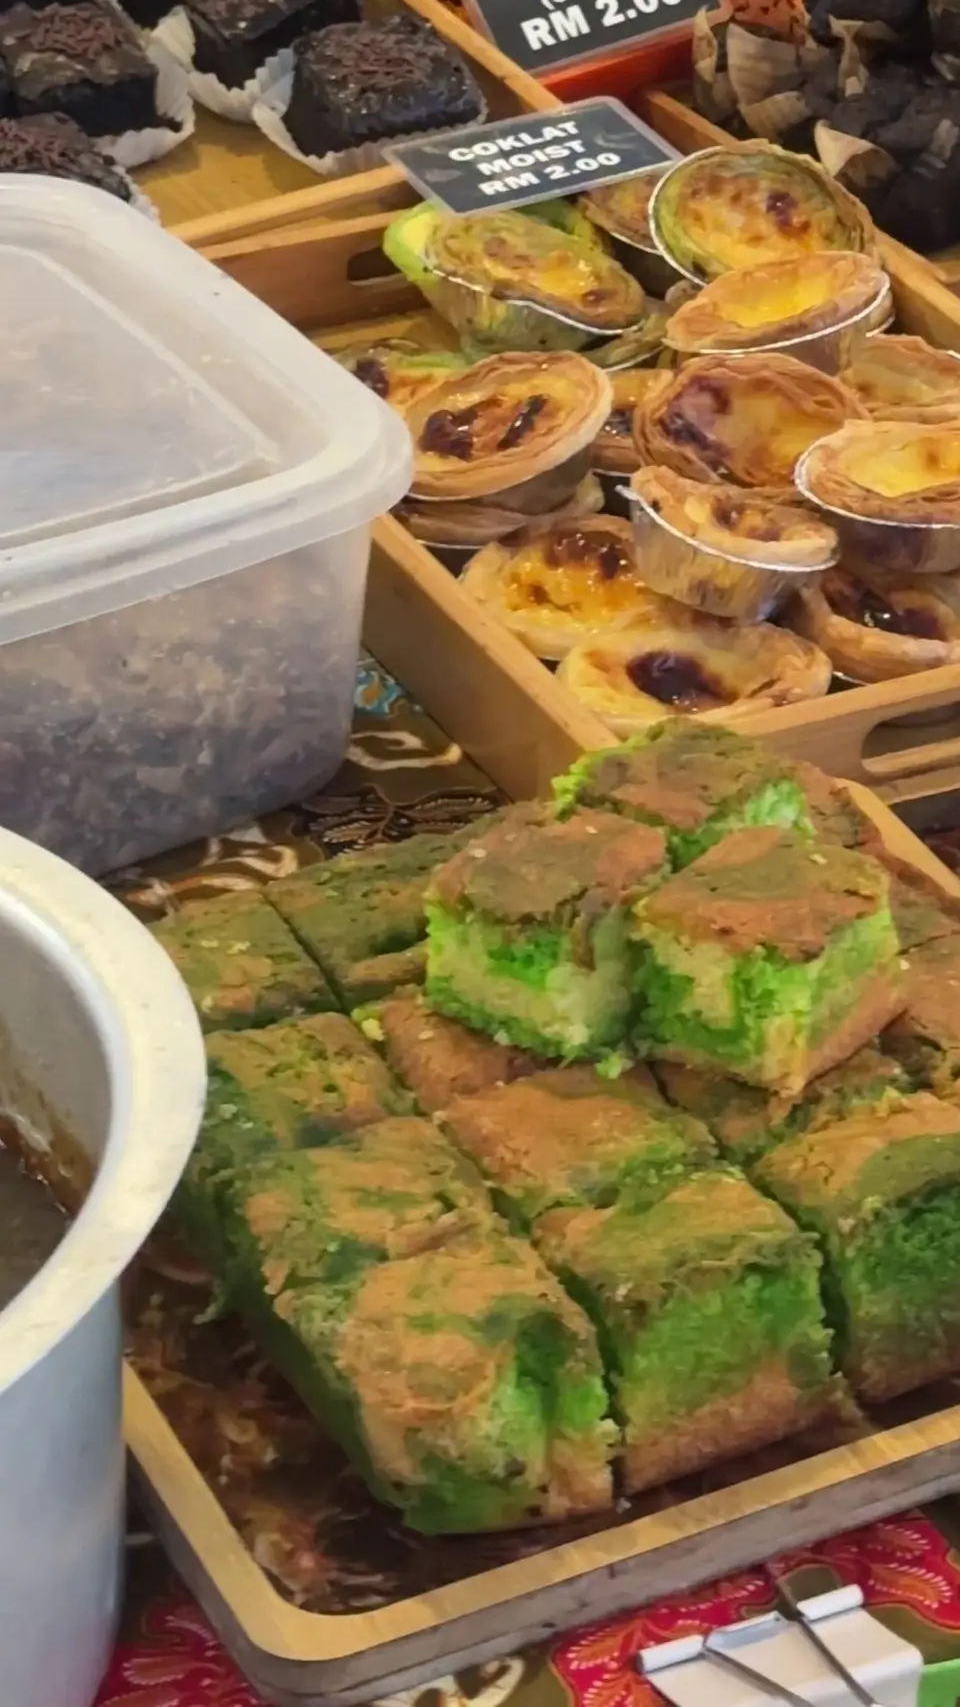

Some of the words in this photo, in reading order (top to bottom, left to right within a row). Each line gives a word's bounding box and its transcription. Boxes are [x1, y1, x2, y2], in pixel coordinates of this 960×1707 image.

[520, 4, 591, 51] RM
[448, 120, 580, 162] COKLAT
[476, 139, 587, 176] MOIST
[477, 171, 541, 195] RM
[544, 152, 621, 179] 2.00
